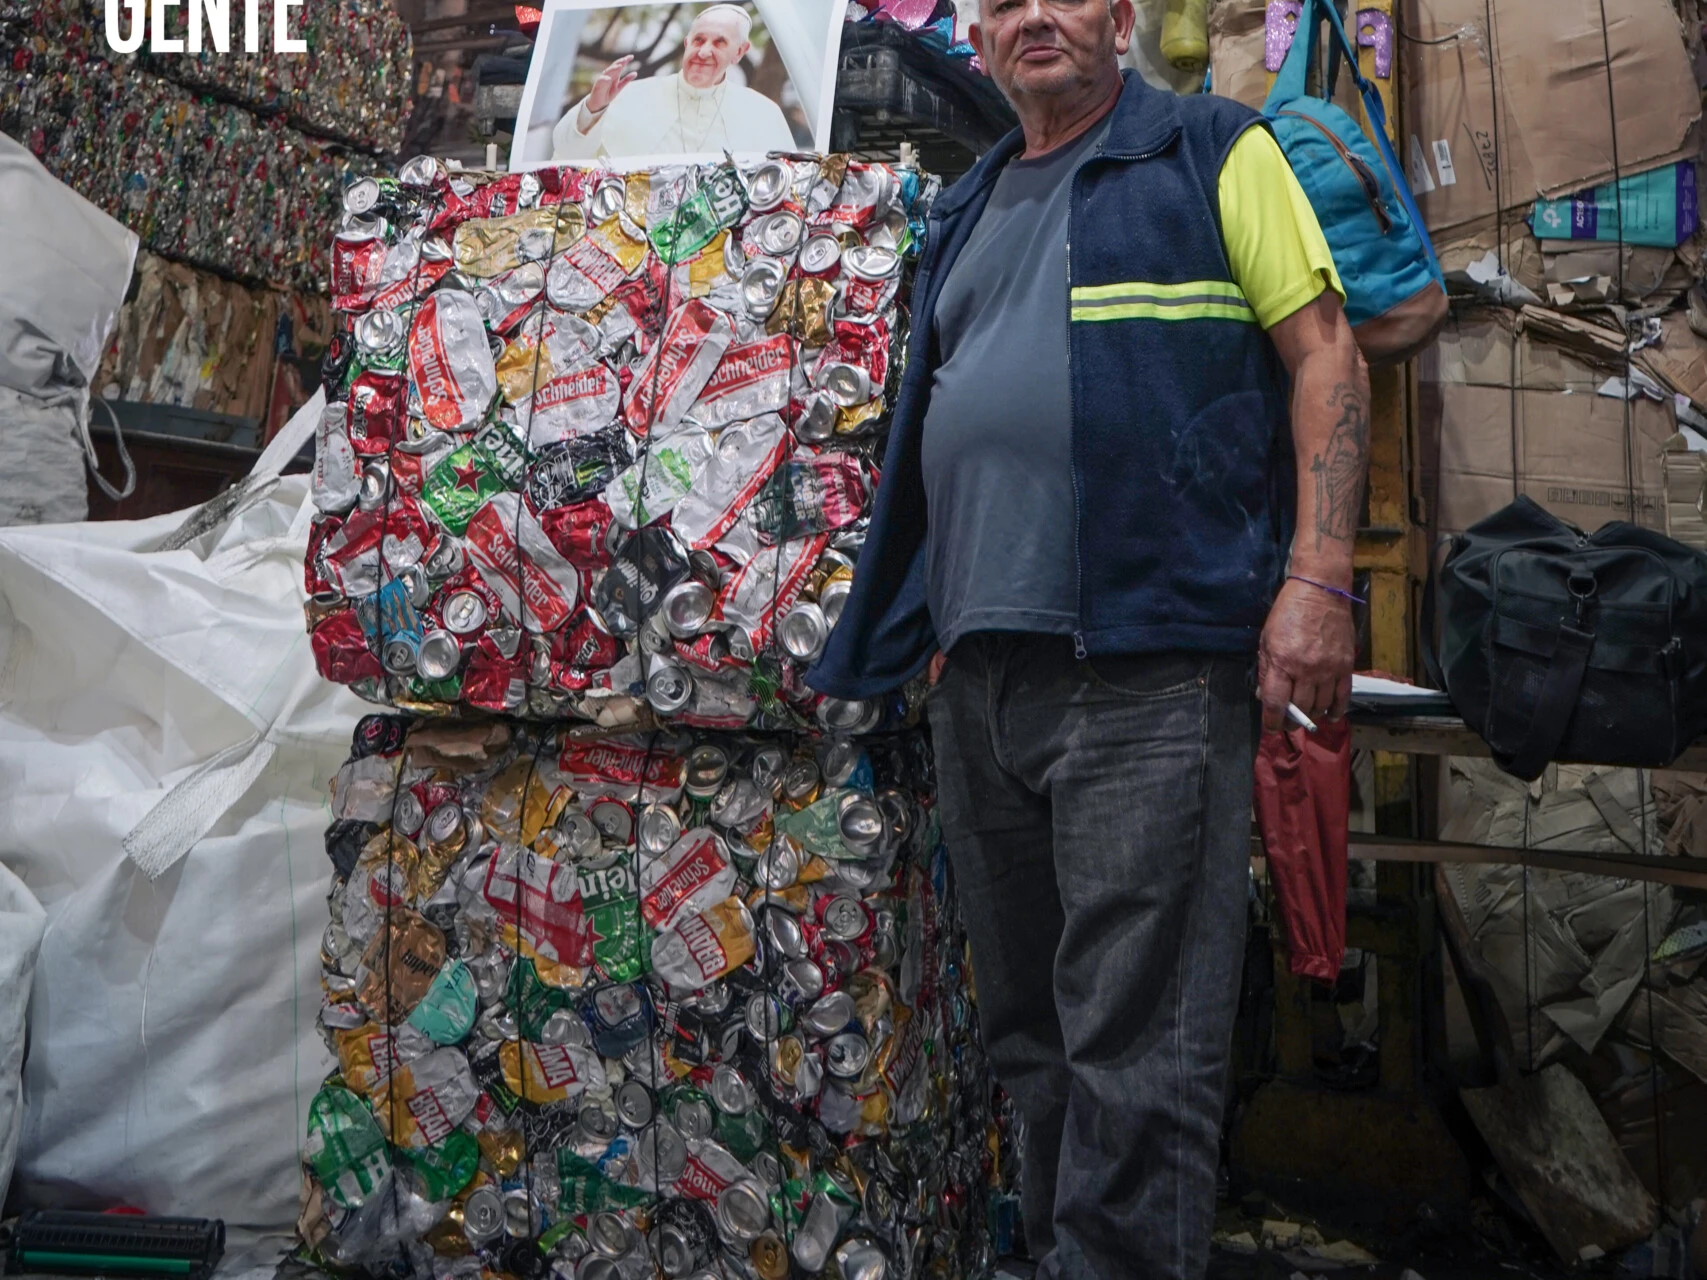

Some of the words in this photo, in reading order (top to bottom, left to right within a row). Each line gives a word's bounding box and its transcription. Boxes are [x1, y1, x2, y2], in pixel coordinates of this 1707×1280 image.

[415, 325, 449, 406] Schneider
[708, 347, 786, 388] Schneider
[801, 472, 816, 520] AMBER
[584, 737, 664, 782] Schneider
[652, 856, 710, 911] Schneider
